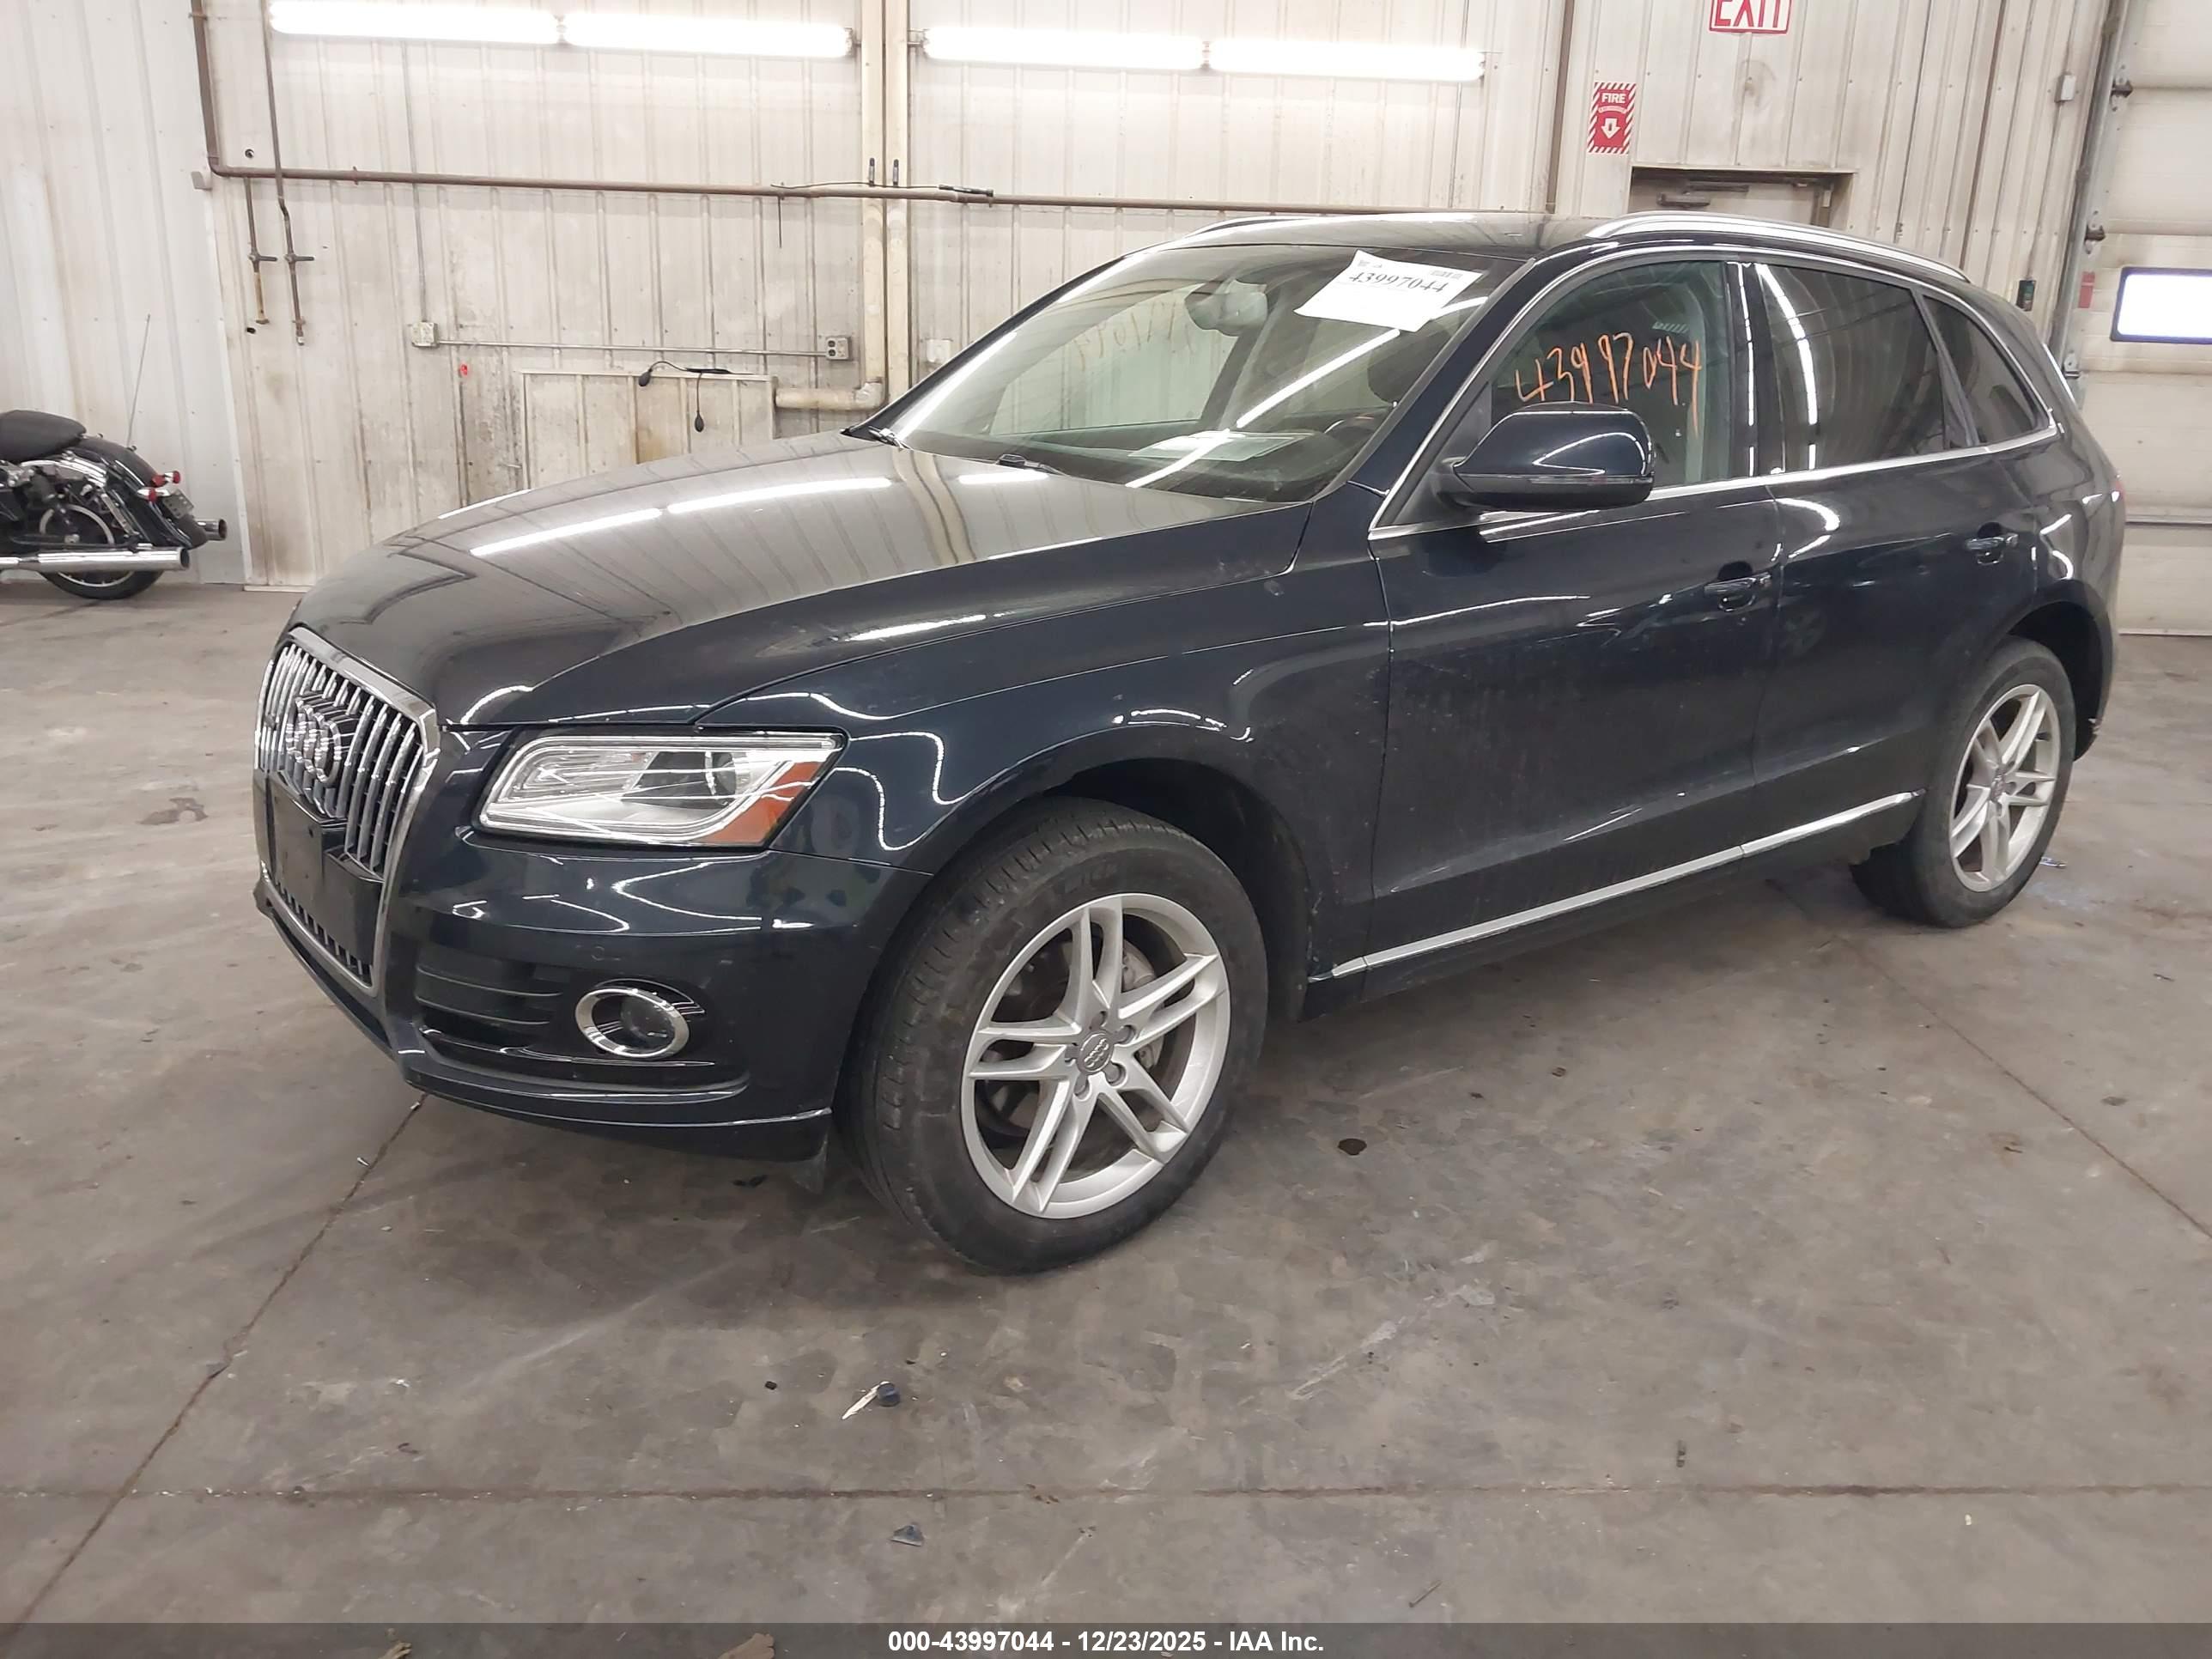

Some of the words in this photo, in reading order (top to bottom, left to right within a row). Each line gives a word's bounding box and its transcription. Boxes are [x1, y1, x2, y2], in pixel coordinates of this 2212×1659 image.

[1601, 93, 1626, 104] FIRE
[1348, 271, 1449, 293] 43997044
[1515, 331, 1702, 439] 43997044
